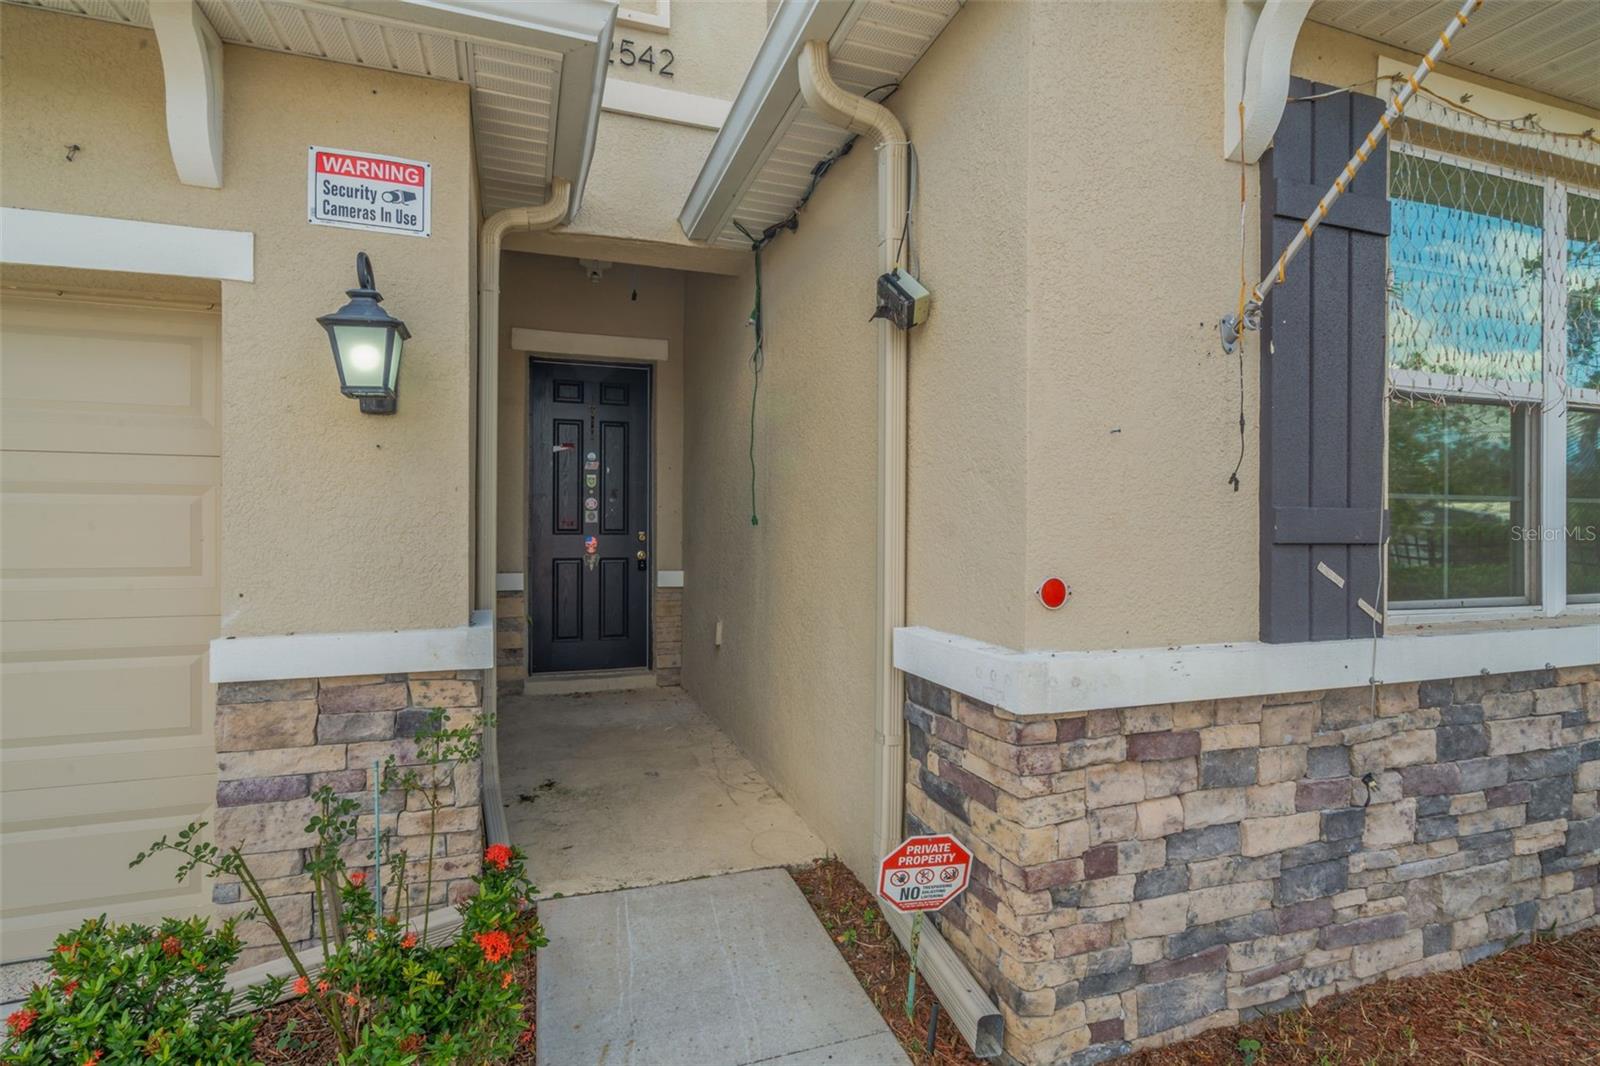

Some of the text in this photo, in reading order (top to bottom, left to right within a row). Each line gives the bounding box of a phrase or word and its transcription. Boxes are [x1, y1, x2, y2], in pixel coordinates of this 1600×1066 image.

[322, 155, 419, 184] WARNING
[323, 179, 377, 204] Security
[323, 199, 376, 221] Cameras
[381, 207, 392, 223] In
[396, 209, 417, 226] Use
[906, 842, 951, 855] PRIVATE
[898, 853, 956, 866] PROPERTY
[900, 886, 920, 901] NO
